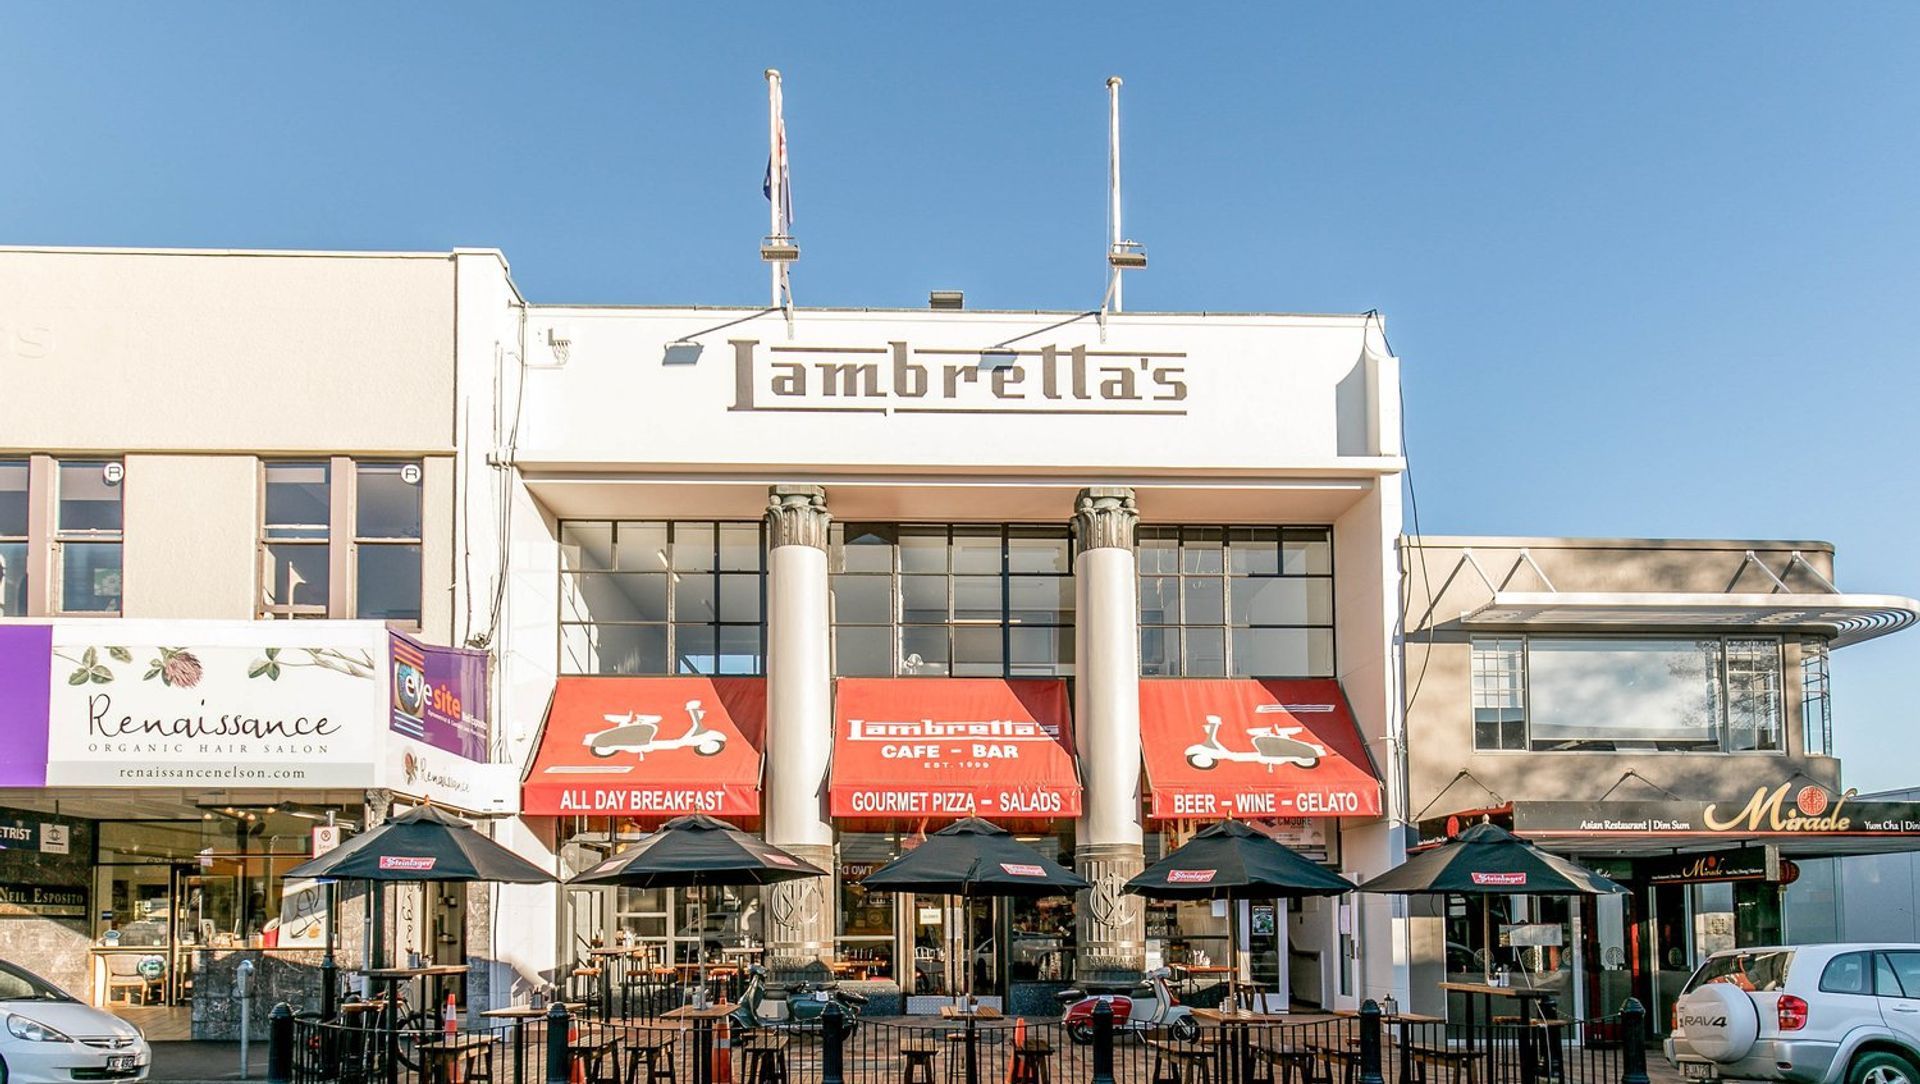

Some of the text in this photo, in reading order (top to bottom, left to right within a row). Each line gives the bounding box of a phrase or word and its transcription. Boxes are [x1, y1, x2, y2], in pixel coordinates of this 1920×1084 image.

[728, 340, 1186, 412] Lambretta's
[89, 693, 342, 738] Renaissance
[847, 719, 1060, 741] Lambretta's
[89, 743, 329, 754] ORGANIC HAIR SALON
[881, 745, 940, 758] CAFE
[972, 744, 1018, 758] BAR
[119, 765, 306, 779] renaissancenelson.com
[924, 761, 953, 769] EST.
[560, 790, 725, 811] ALL DAY BREAKFAST
[852, 792, 929, 811] GOURMET
[932, 792, 976, 811] PIZZA
[1000, 792, 1061, 811] SALADS
[1174, 794, 1217, 814] BEER
[1236, 793, 1276, 812] WINE
[1296, 792, 1358, 812] GELATO
[1703, 782, 1858, 831] Miracle
[1580, 820, 1603, 830] Asian
[1604, 820, 1647, 830] Restaurant
[1653, 820, 1672, 830] Dim
[1673, 820, 1690, 830] Sum
[1864, 820, 1882, 830] Yum
[1883, 820, 1899, 830] Cha
[0, 886, 27, 902] NEIL
[1684, 1016, 1728, 1027] RAV4
